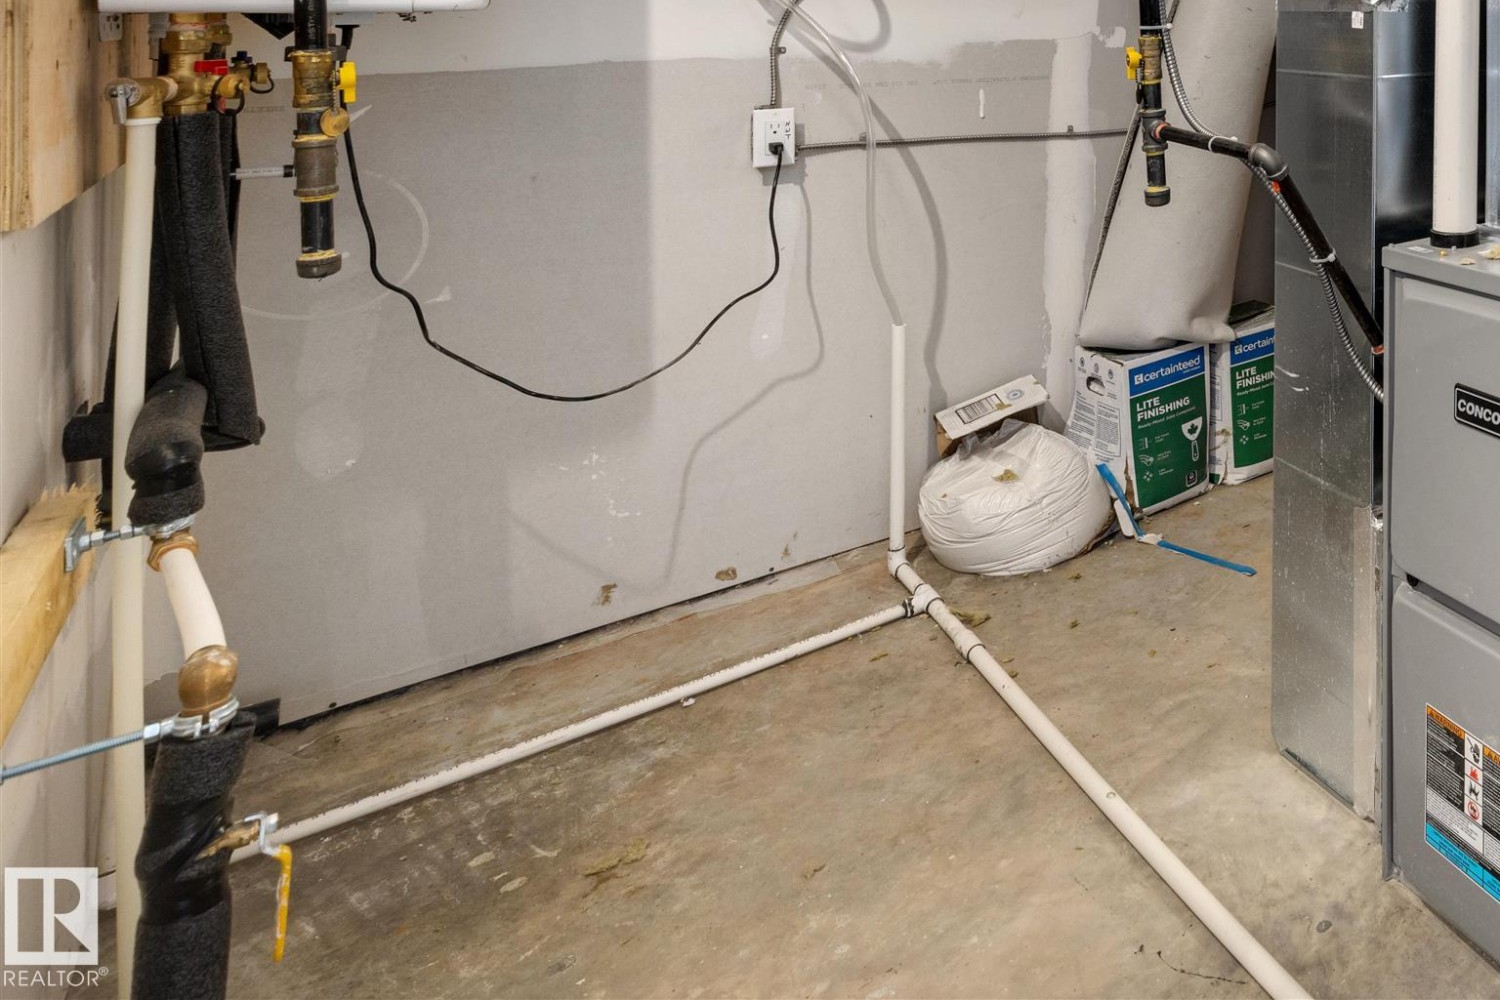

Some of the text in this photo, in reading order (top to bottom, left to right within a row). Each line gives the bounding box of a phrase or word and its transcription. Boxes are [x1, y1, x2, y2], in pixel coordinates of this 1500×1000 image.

[1143, 355, 1200, 382] certainteed
[1235, 366, 1257, 380] LITE
[1236, 370, 1275, 390] FINISHIN
[1136, 396, 1160, 412] LITE
[1137, 396, 1190, 421] FINISHING
[1434, 711, 1464, 738] WARNING
